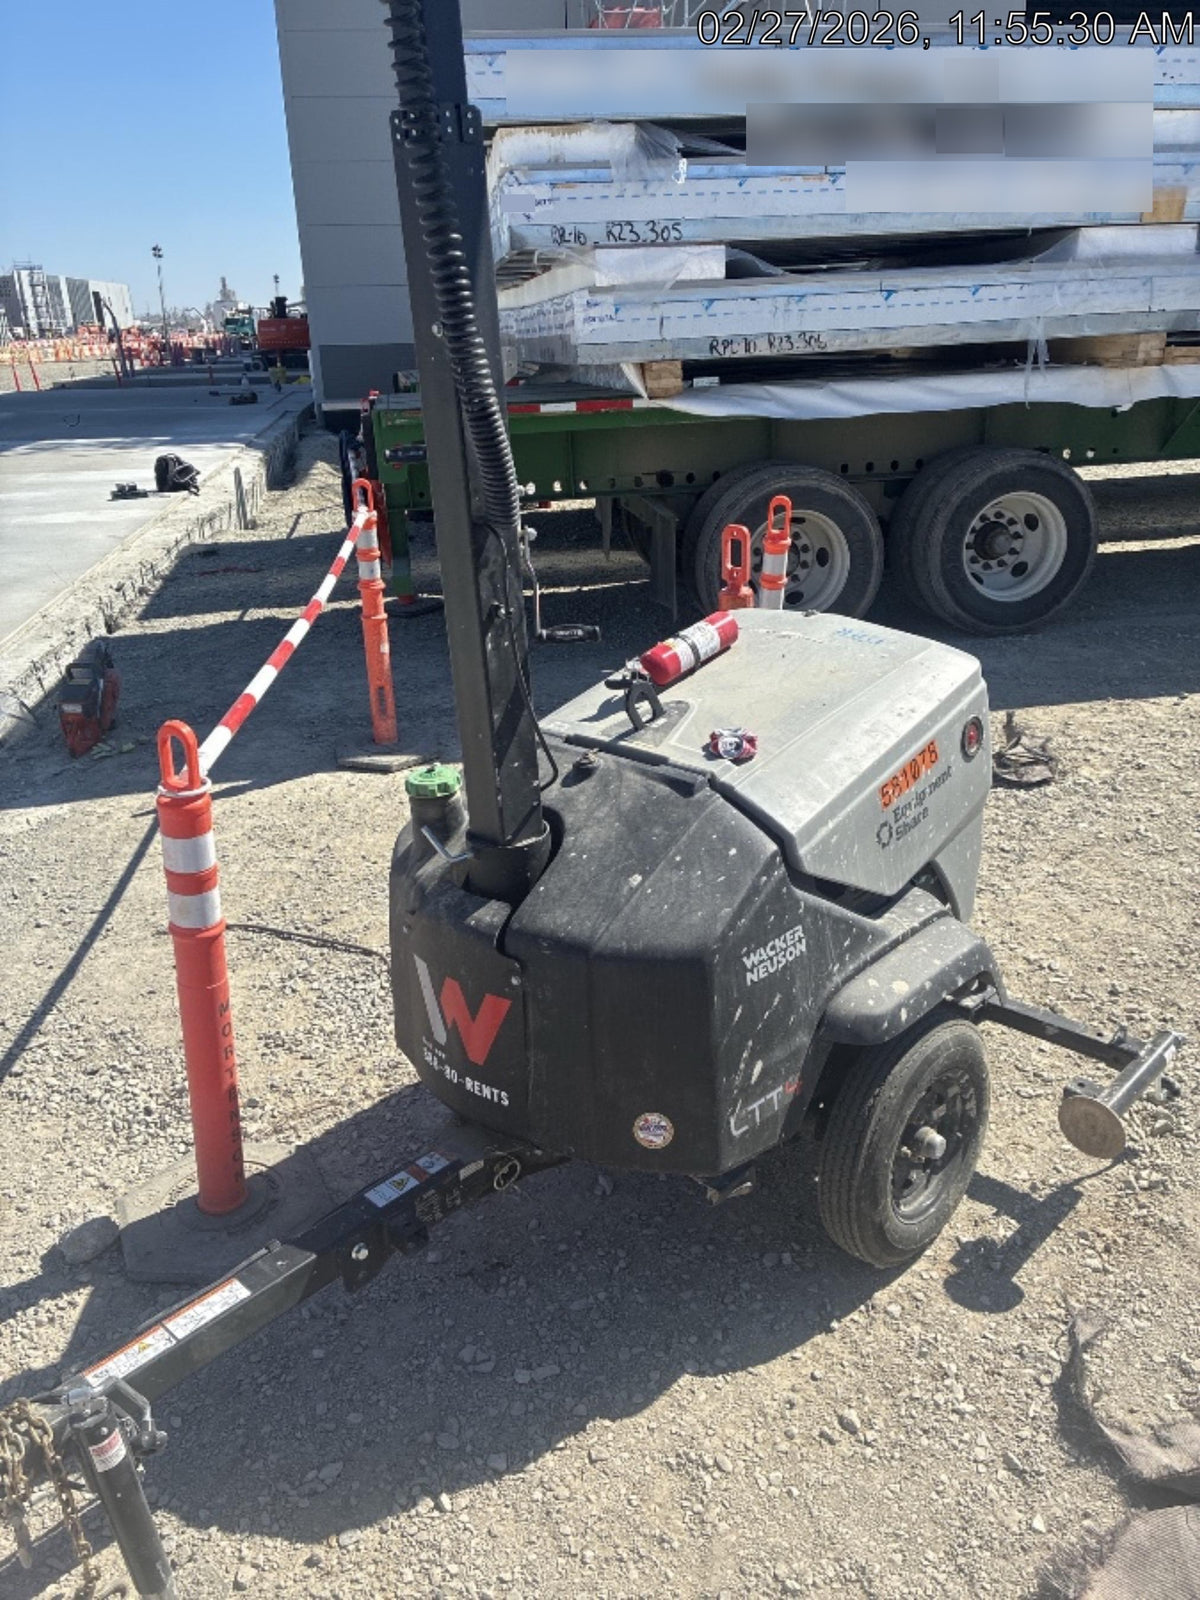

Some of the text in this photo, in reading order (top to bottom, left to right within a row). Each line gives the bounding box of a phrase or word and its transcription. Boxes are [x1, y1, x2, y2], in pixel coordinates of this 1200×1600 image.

[880, 740, 939, 809] 581078
[742, 924, 805, 969] WACKER
[746, 938, 807, 987] NEUSON
